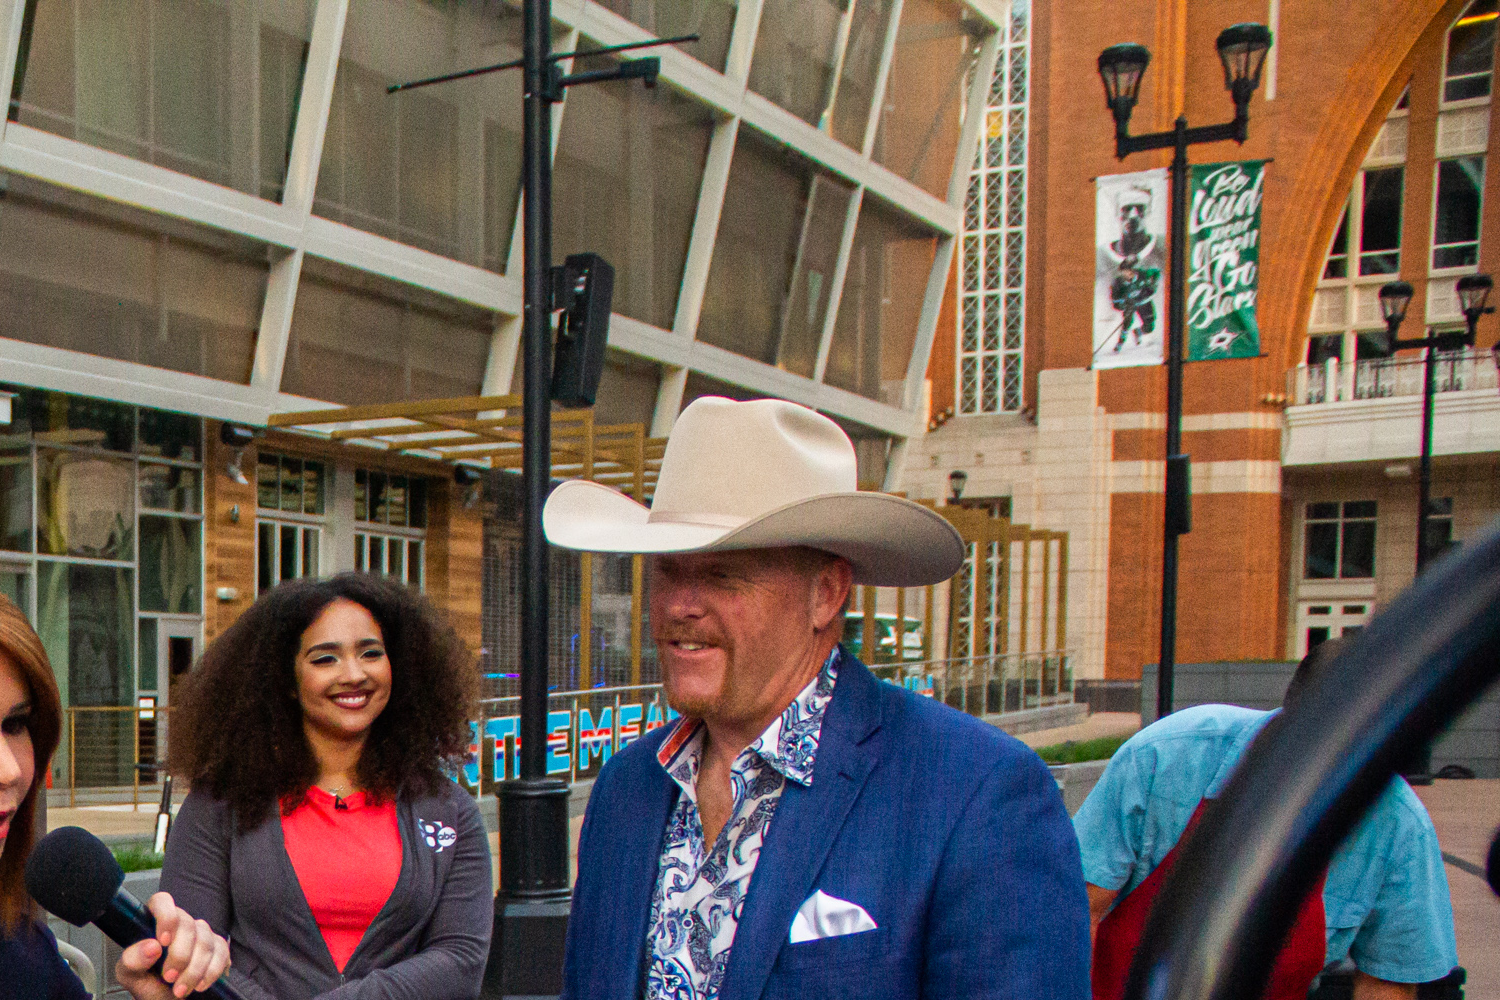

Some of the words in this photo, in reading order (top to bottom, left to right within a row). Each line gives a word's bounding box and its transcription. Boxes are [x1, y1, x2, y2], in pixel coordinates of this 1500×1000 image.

[1203, 164, 1251, 198] Be
[1189, 166, 1266, 235] Loud
[438, 831, 456, 841] abc
